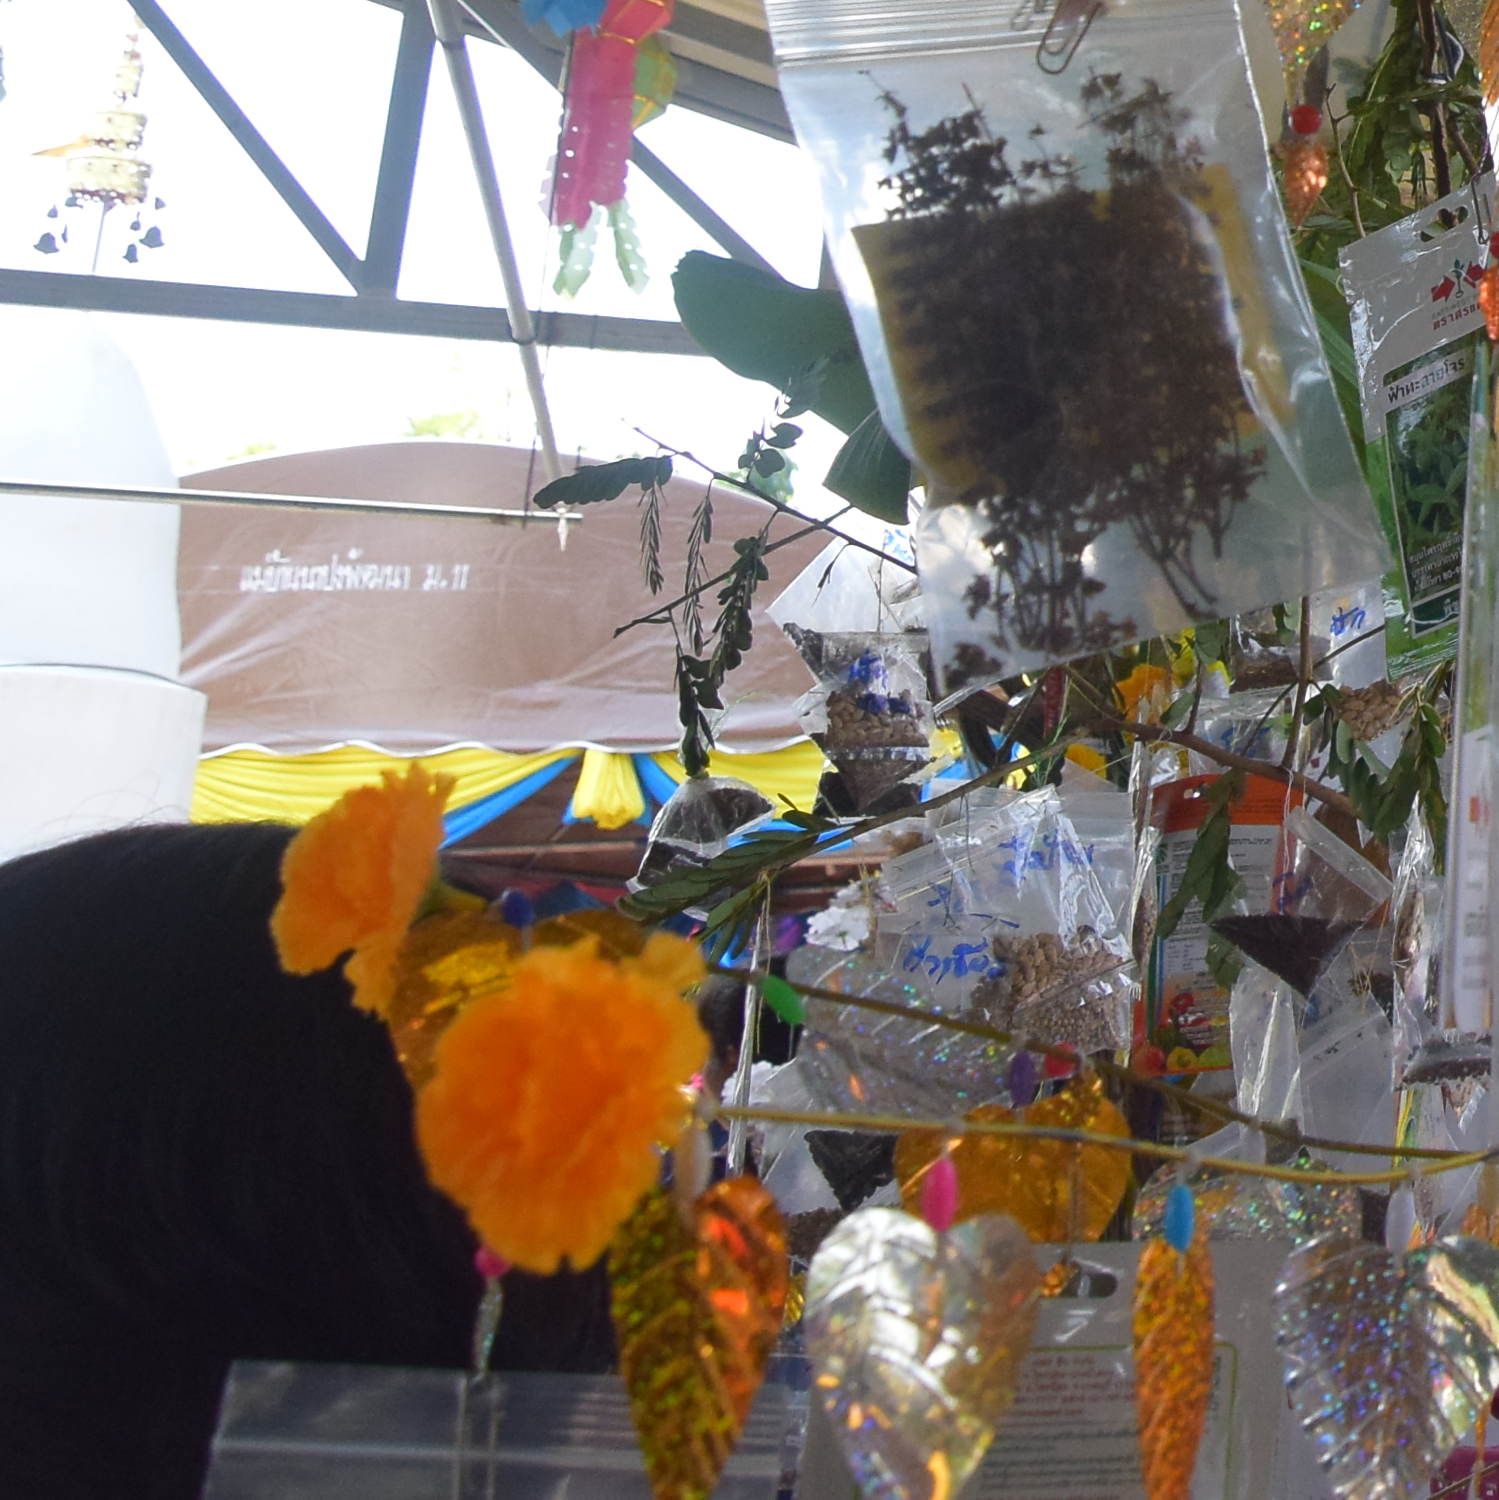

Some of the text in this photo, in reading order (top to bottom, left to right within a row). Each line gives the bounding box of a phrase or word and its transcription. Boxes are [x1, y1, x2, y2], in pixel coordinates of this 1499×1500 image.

[1432, 303, 1482, 331] ตราศรแ
[1387, 357, 1466, 405] ฟ้าทะลายโจร
